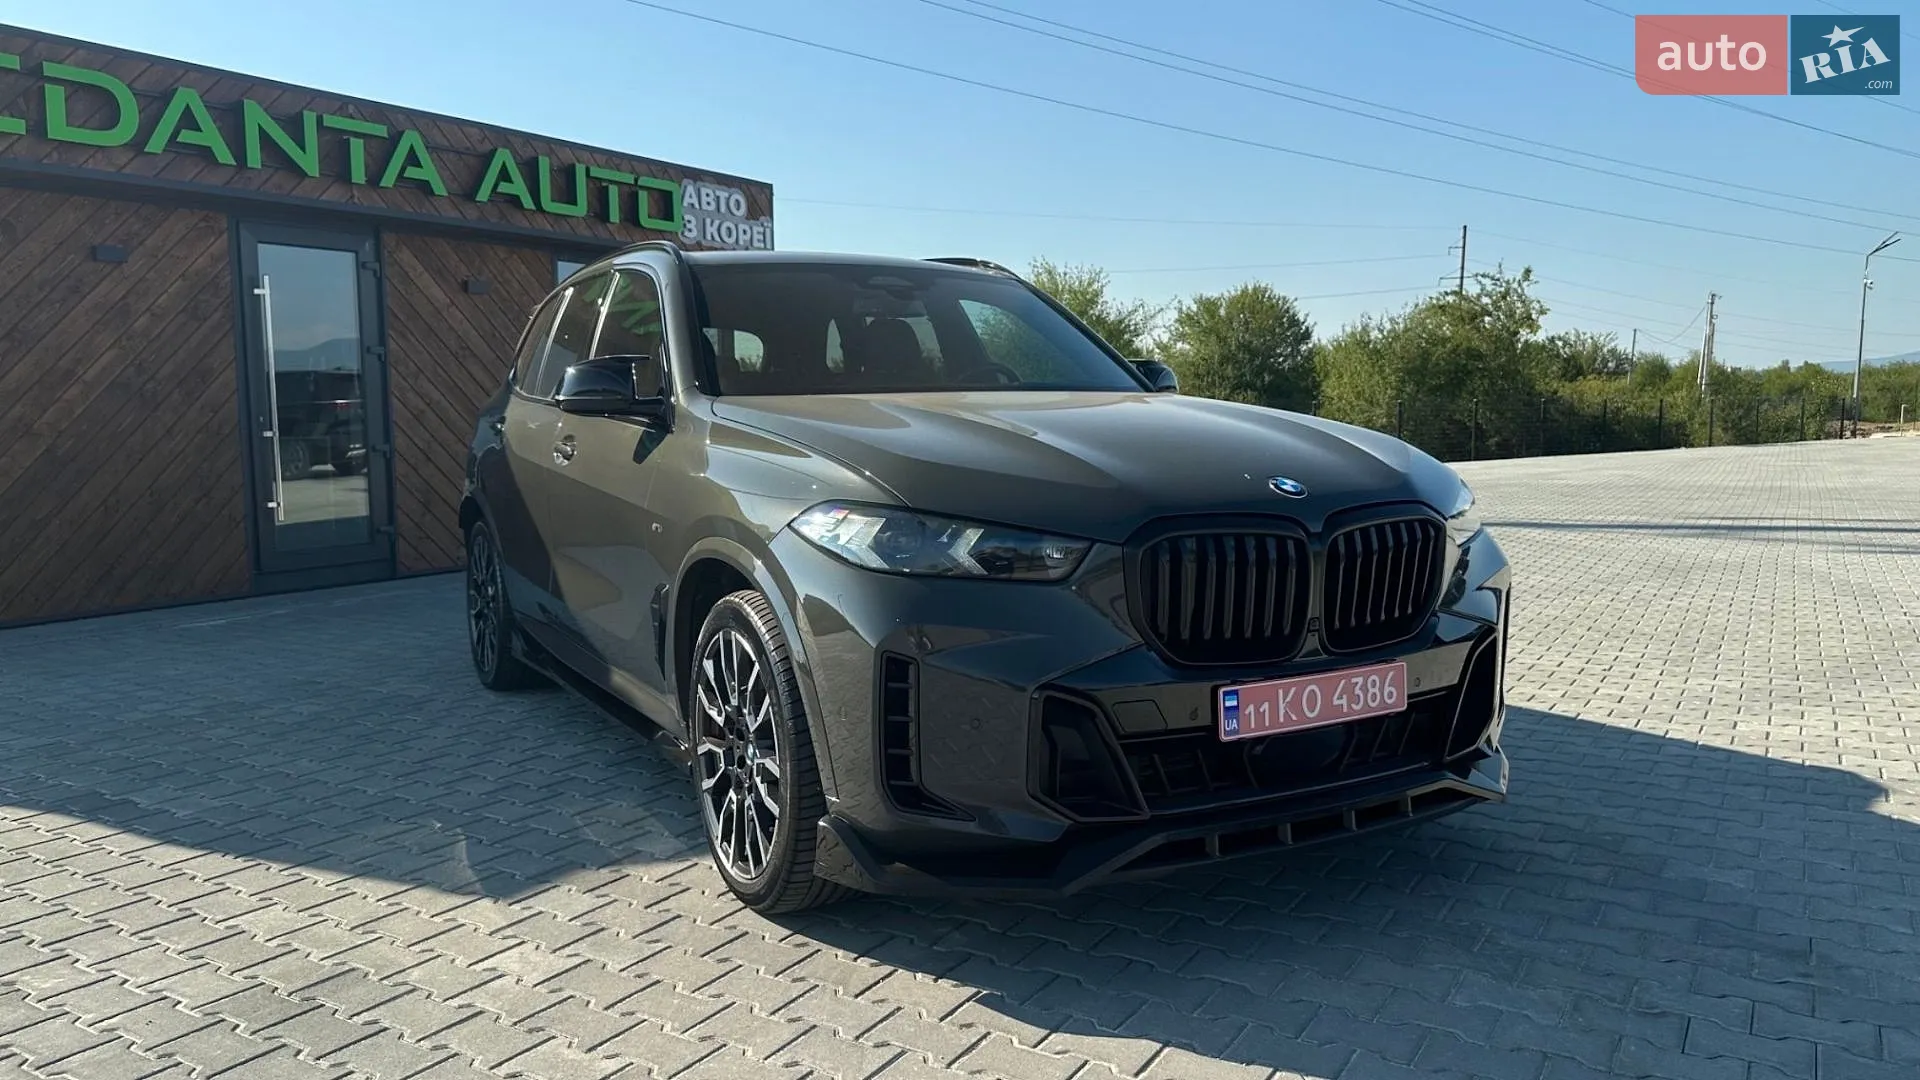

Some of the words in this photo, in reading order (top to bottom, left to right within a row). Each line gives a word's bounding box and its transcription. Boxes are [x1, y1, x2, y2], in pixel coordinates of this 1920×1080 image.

[476, 147, 684, 233] AUTO
[682, 183, 746, 217] АВТО
[704, 217, 772, 249] КОРЕЇ
[1332, 671, 1397, 713] 4386
[1225, 718, 1238, 731] UA
